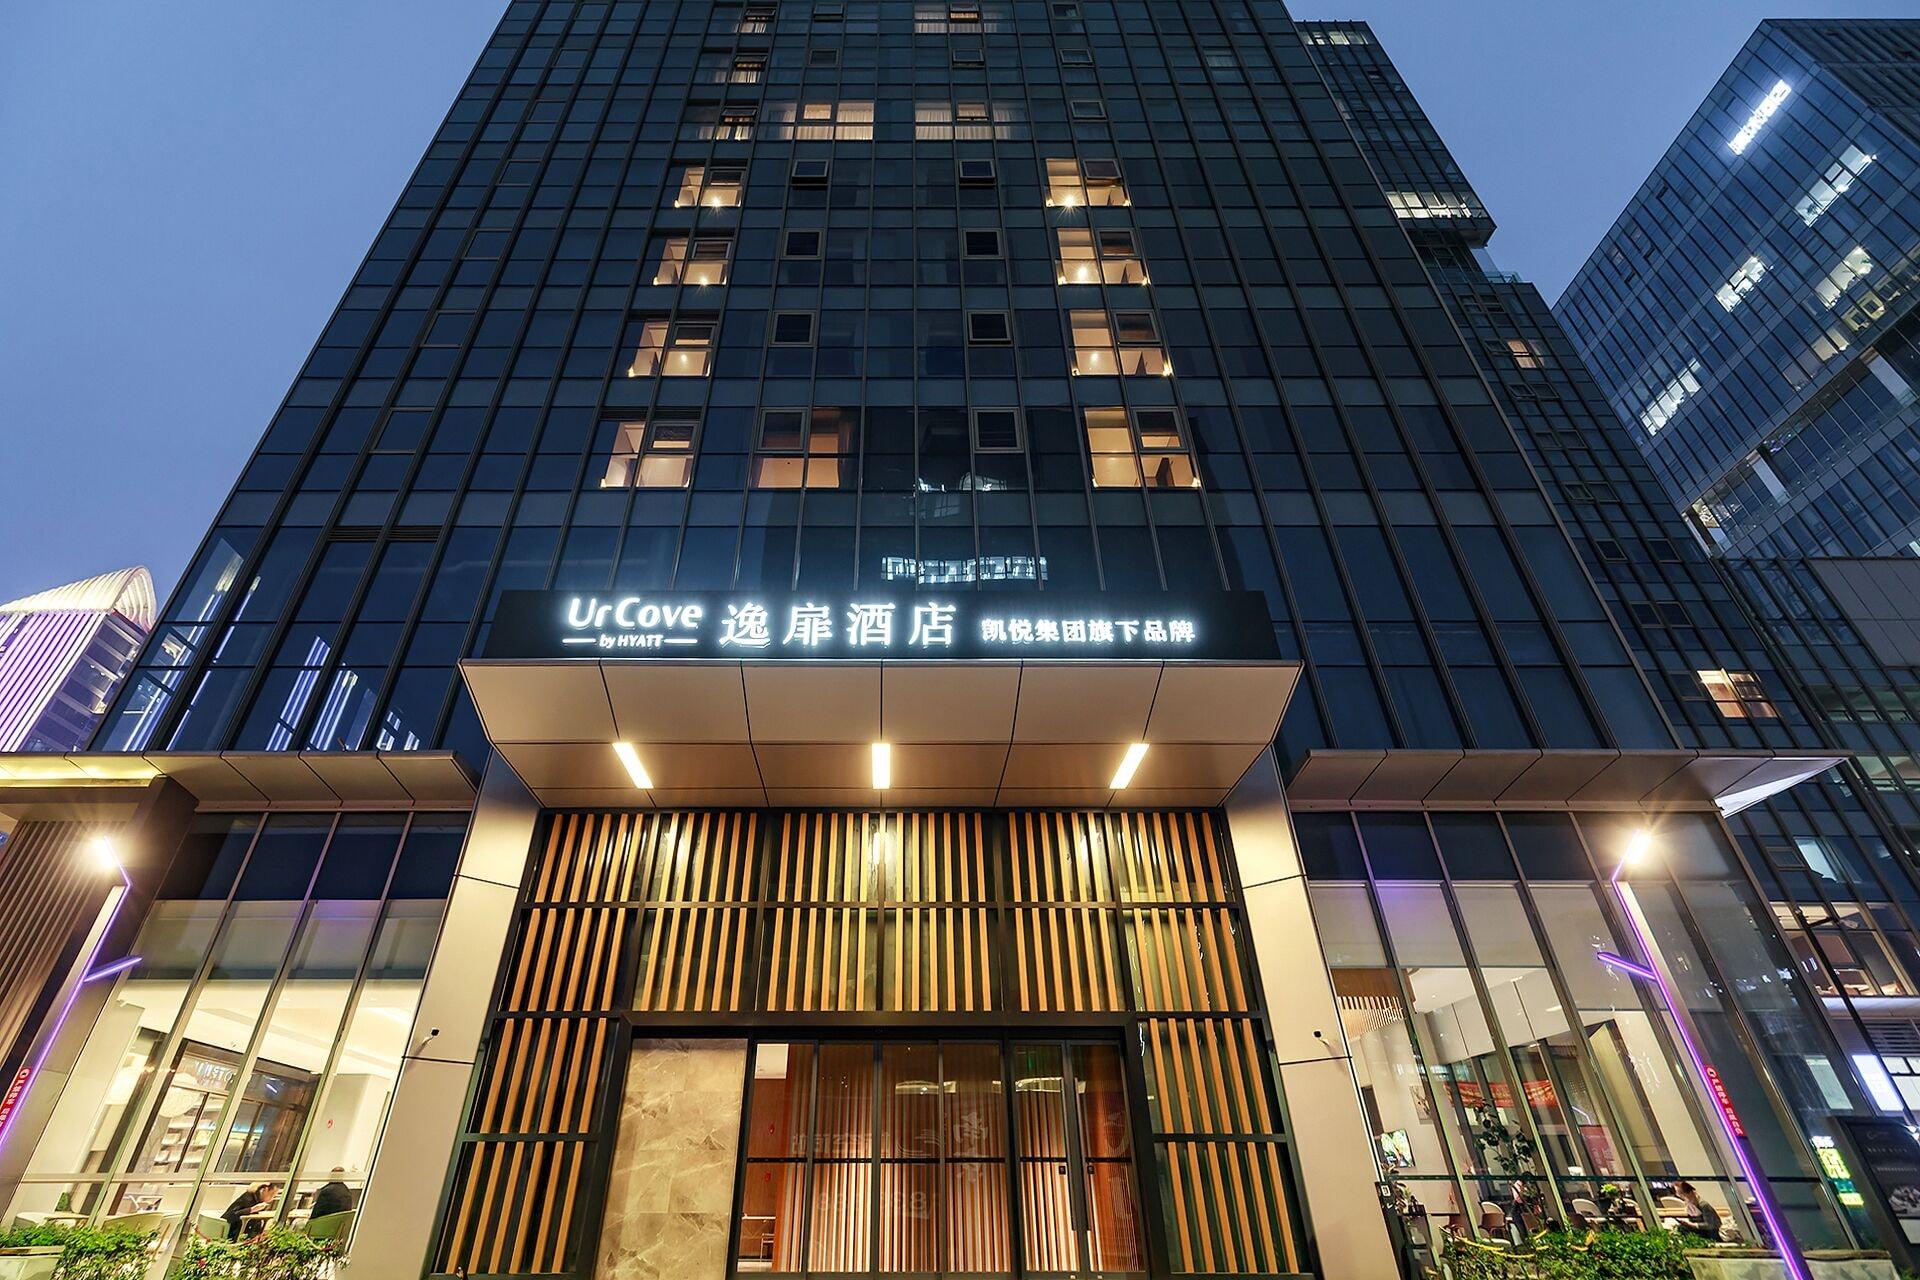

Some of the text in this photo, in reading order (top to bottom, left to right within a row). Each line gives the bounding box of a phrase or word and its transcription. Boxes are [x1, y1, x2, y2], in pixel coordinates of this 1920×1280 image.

[567, 597, 703, 629] UrCove
[719, 602, 957, 648] 逸扉酒店
[599, 634, 664, 649] by HYATT
[981, 618, 1196, 643] 凯悦集团旗下品牌
